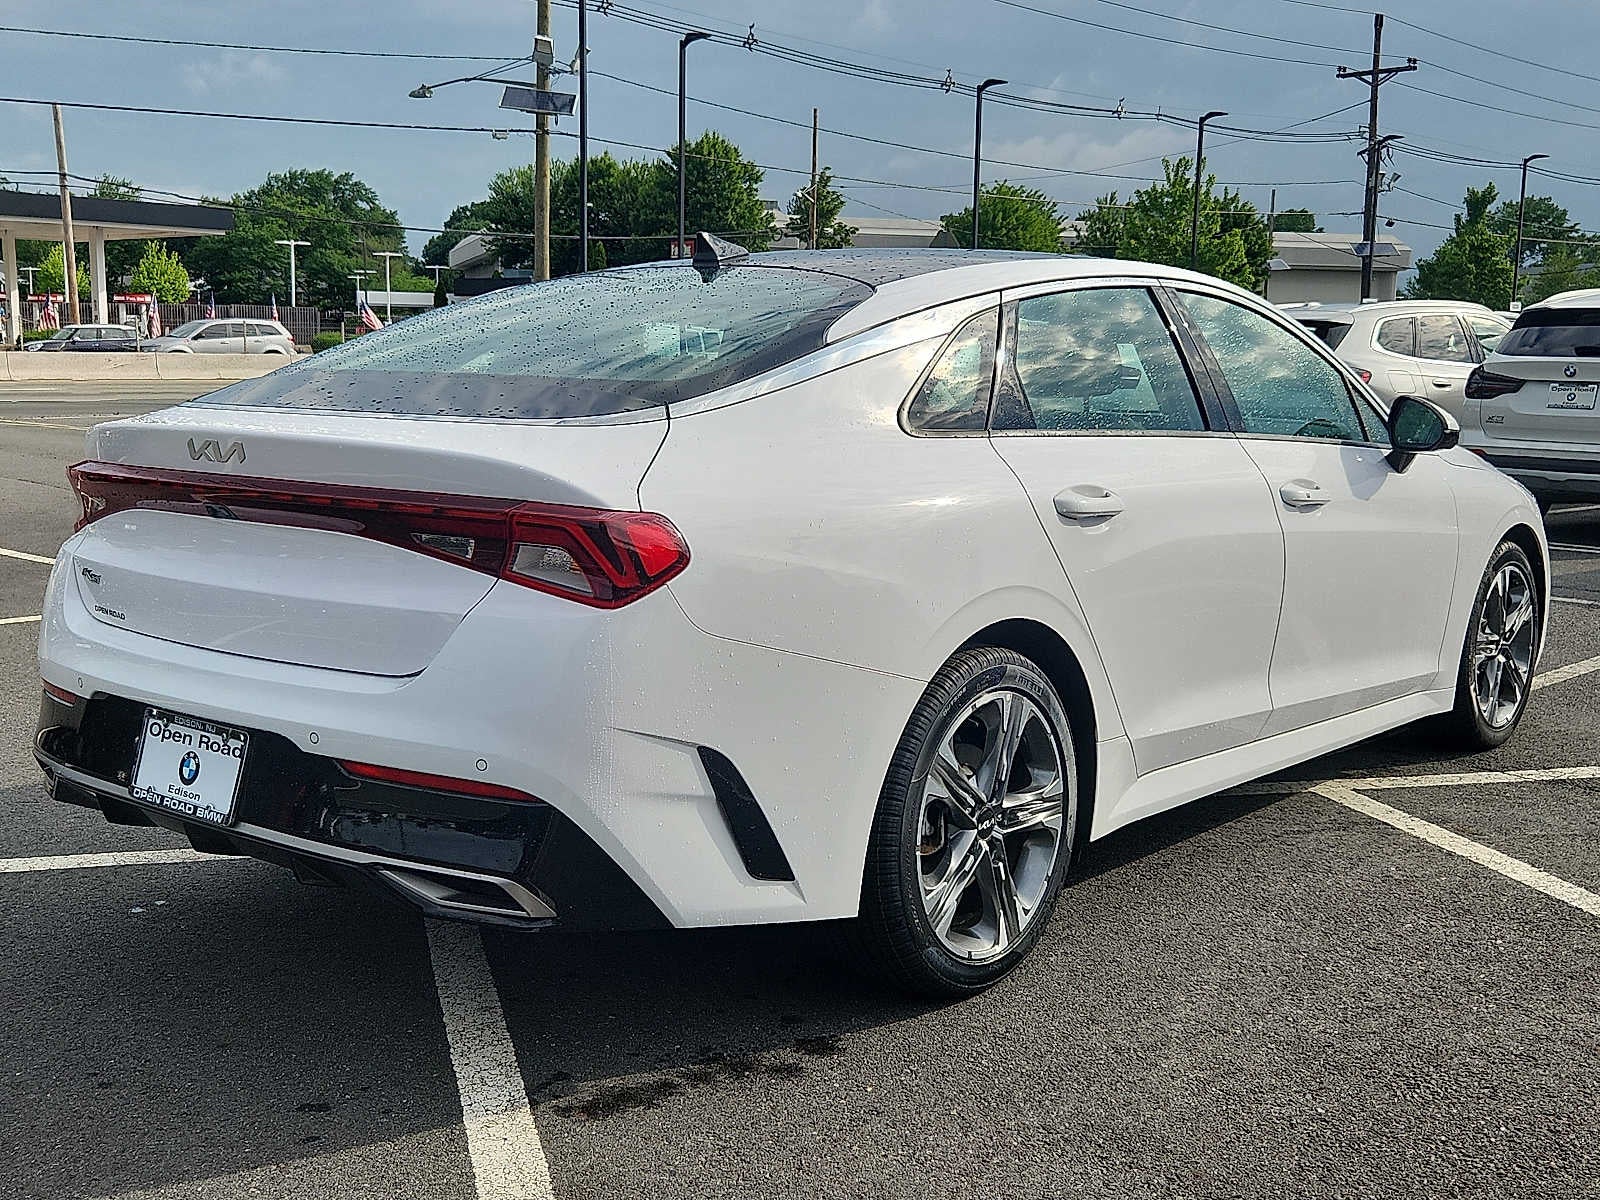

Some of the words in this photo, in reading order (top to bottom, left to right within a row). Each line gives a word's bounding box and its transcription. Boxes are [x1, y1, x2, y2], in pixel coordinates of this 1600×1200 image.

[94, 604, 109, 615] OPEN
[108, 609, 126, 620] ROAD
[205, 724, 217, 733] NJ
[149, 721, 193, 746] Open
[199, 734, 242, 759] Road
[168, 784, 201, 802] Edison
[133, 787, 162, 804] OPEN
[163, 797, 194, 814] ROAD
[196, 808, 225, 823] BMW
